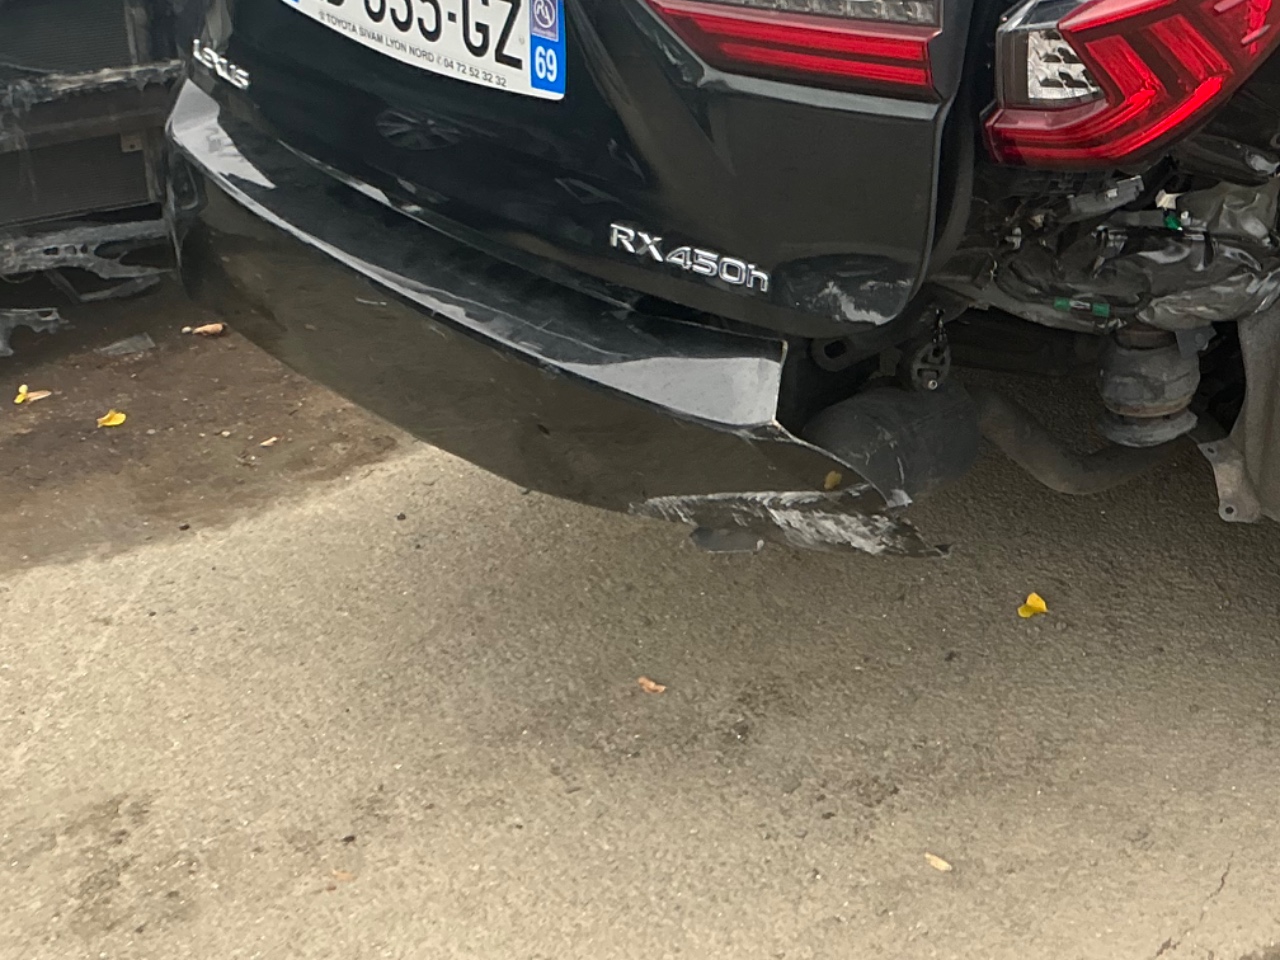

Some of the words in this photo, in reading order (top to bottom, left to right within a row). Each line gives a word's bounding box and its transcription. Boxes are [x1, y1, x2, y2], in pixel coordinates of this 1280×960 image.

[326, 13, 358, 33] TOYOTA
[385, 35, 407, 53] LYON
[408, 46, 434, 63] NORD
[535, 45, 558, 82] 69
